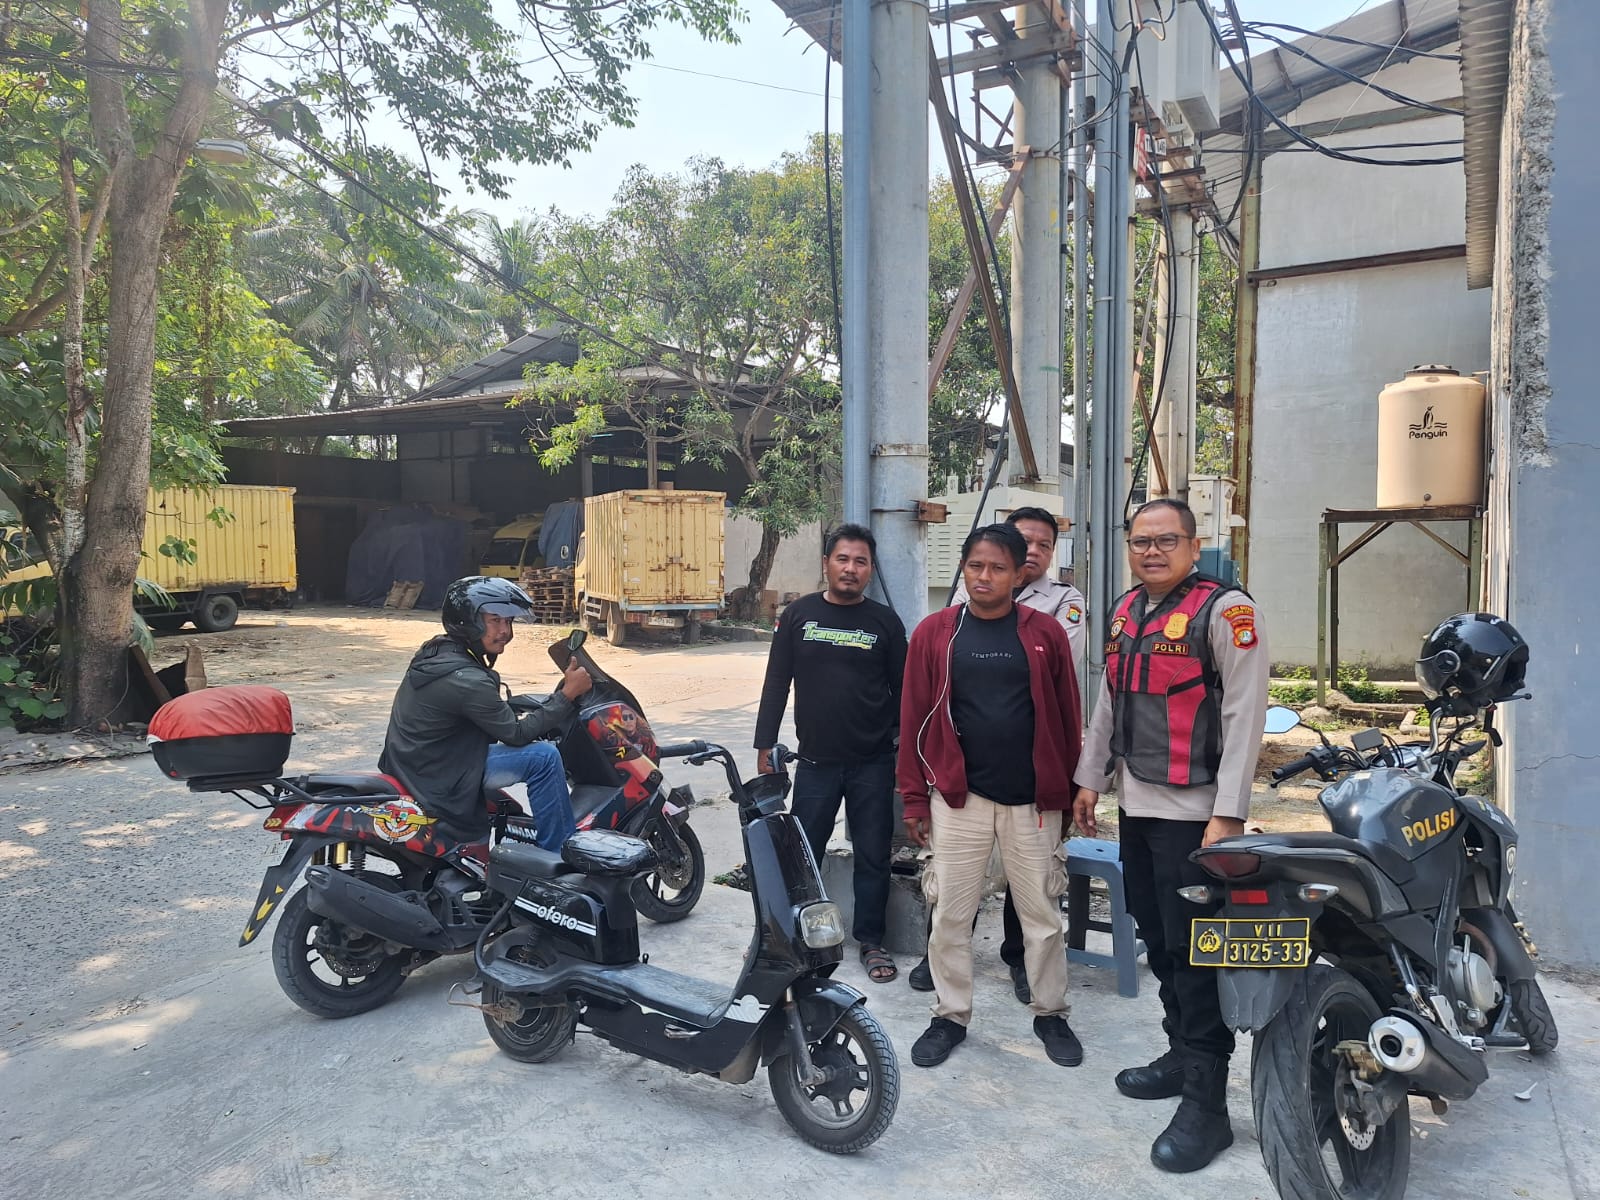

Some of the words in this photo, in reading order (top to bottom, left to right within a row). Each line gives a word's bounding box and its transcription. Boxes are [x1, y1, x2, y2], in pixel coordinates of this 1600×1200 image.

[1409, 429, 1448, 440] Penguin
[802, 621, 878, 644] Transporter
[1154, 643, 1186, 653] POLRI
[1401, 808, 1455, 847] POLISI
[537, 905, 578, 930] ofero
[1254, 924, 1281, 937] VII
[1229, 942, 1303, 962] 3125-33
